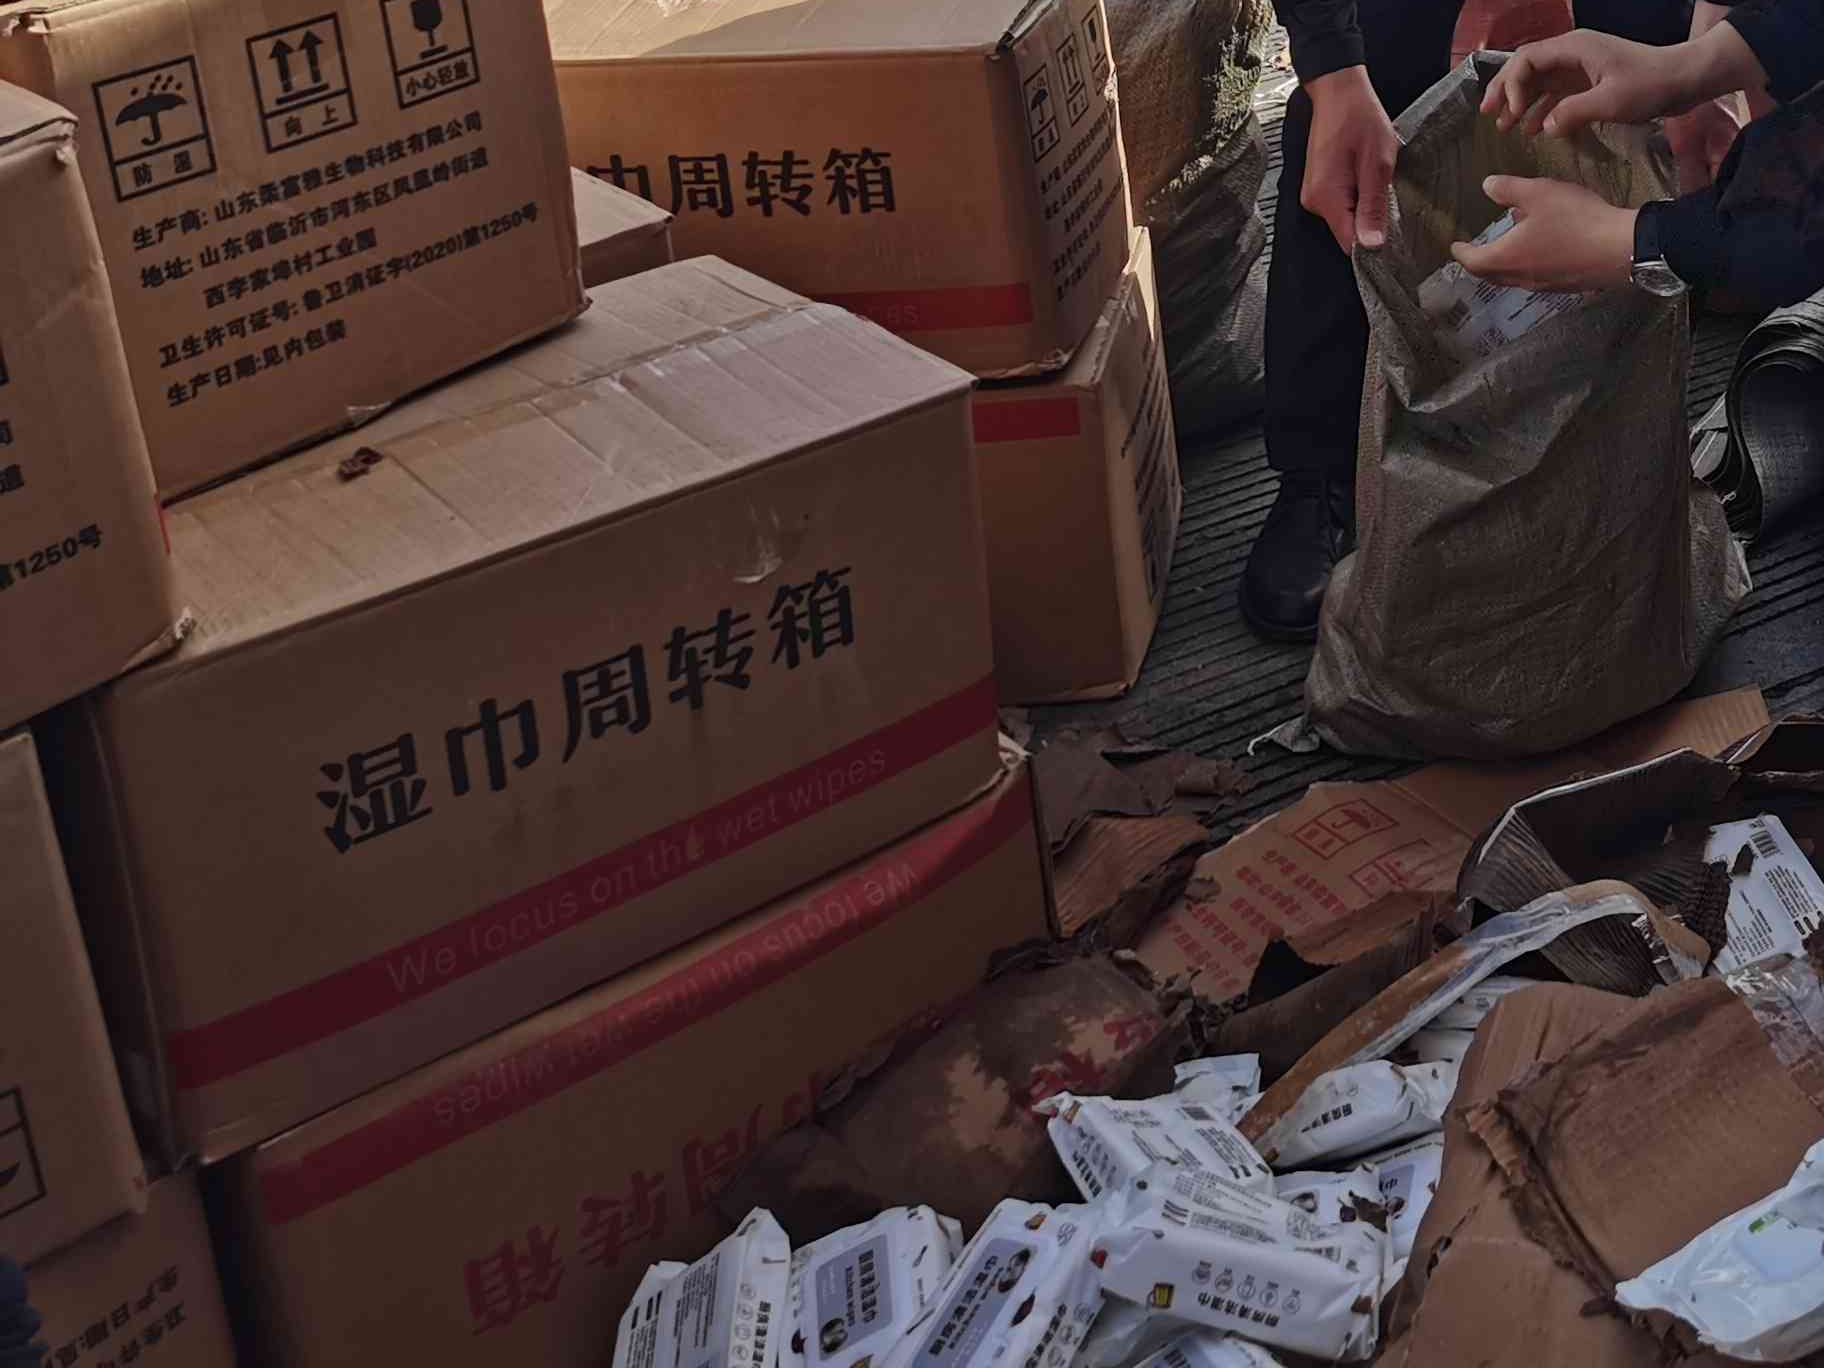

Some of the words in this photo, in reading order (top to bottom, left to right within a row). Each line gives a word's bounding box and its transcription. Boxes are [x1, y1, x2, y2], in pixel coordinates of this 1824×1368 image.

[316, 565, 856, 854] 湿巾周转箱
[386, 937, 459, 995] We
[468, 887, 580, 962] focus
[587, 859, 638, 909] on
[647, 817, 705, 881] the
[714, 796, 784, 857] wet
[787, 745, 888, 815] wipes
